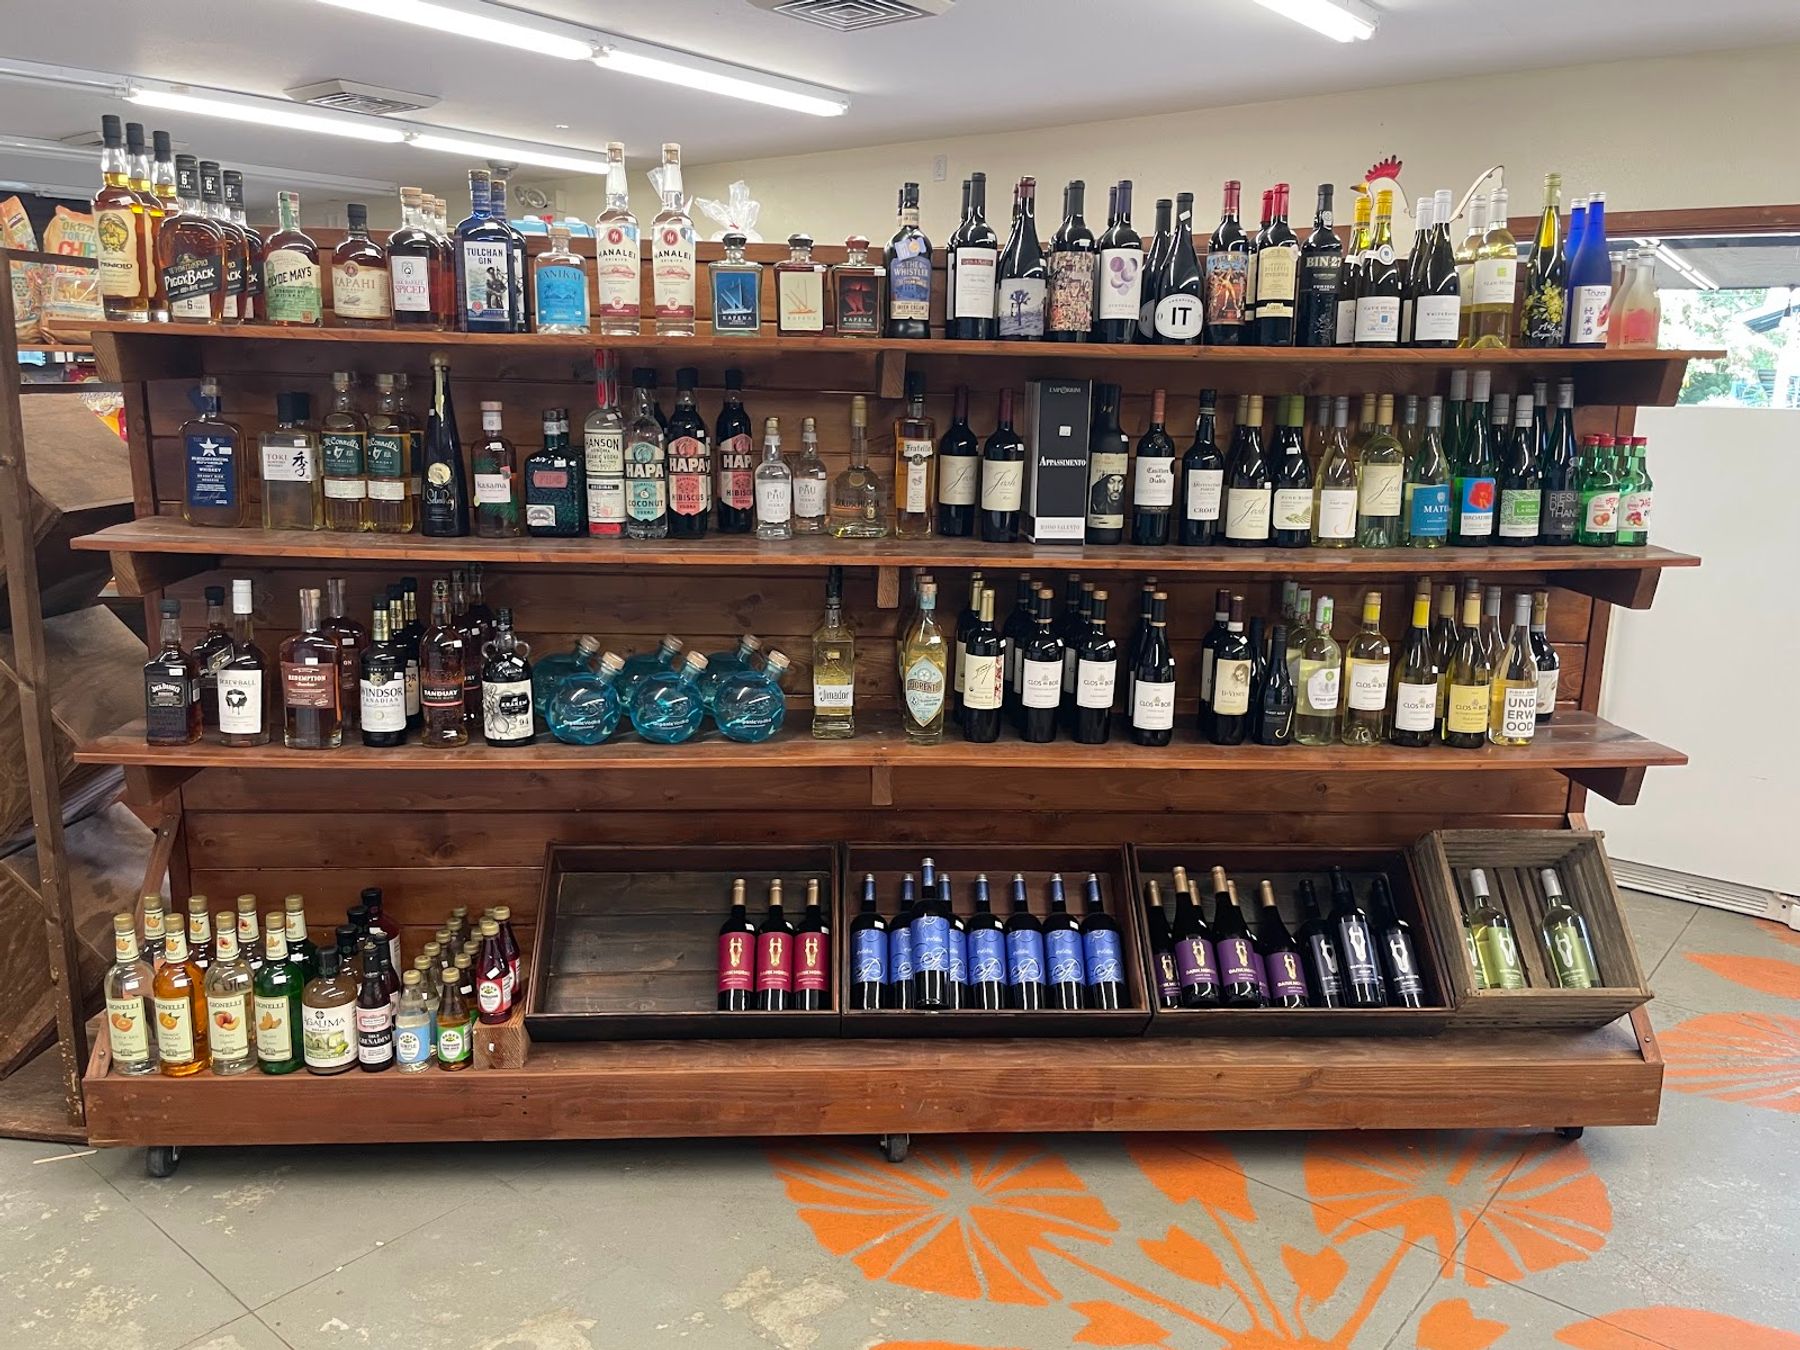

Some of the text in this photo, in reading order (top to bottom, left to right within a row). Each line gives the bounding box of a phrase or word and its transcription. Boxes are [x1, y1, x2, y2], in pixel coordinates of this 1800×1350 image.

[181, 175, 187, 186] 6
[206, 180, 212, 190] 6
[227, 187, 232, 198] 6
[466, 247, 503, 258] TULCHAN
[478, 257, 492, 266] GIN
[1306, 256, 1329, 268] BIN
[395, 286, 426, 296] SPICED
[187, 300, 193, 310] 6
[1171, 306, 1193, 326] IT
[267, 453, 288, 462] TOKI
[1039, 456, 1087, 468] APPASSIMENTO
[669, 457, 706, 472] HAPA
[626, 463, 664, 478] HAPA
[477, 480, 507, 490] kasama
[767, 490, 785, 500] PAU
[798, 486, 817, 496] PAU
[672, 493, 704, 501] HIBISCUS
[628, 500, 663, 508] COCONUT
[288, 674, 326, 682] REDEMPTION
[1029, 679, 1043, 687] CLOS
[1084, 679, 1098, 687] CLOS
[1356, 681, 1371, 689] CLOS
[424, 689, 458, 697] TANDUAY
[820, 687, 849, 702] Jimador
[1403, 702, 1419, 710] CLOS
[1456, 702, 1471, 710] CLOS
[1508, 698, 1536, 708] UND
[1507, 709, 1535, 719] ERW
[1506, 721, 1534, 731] OOD
